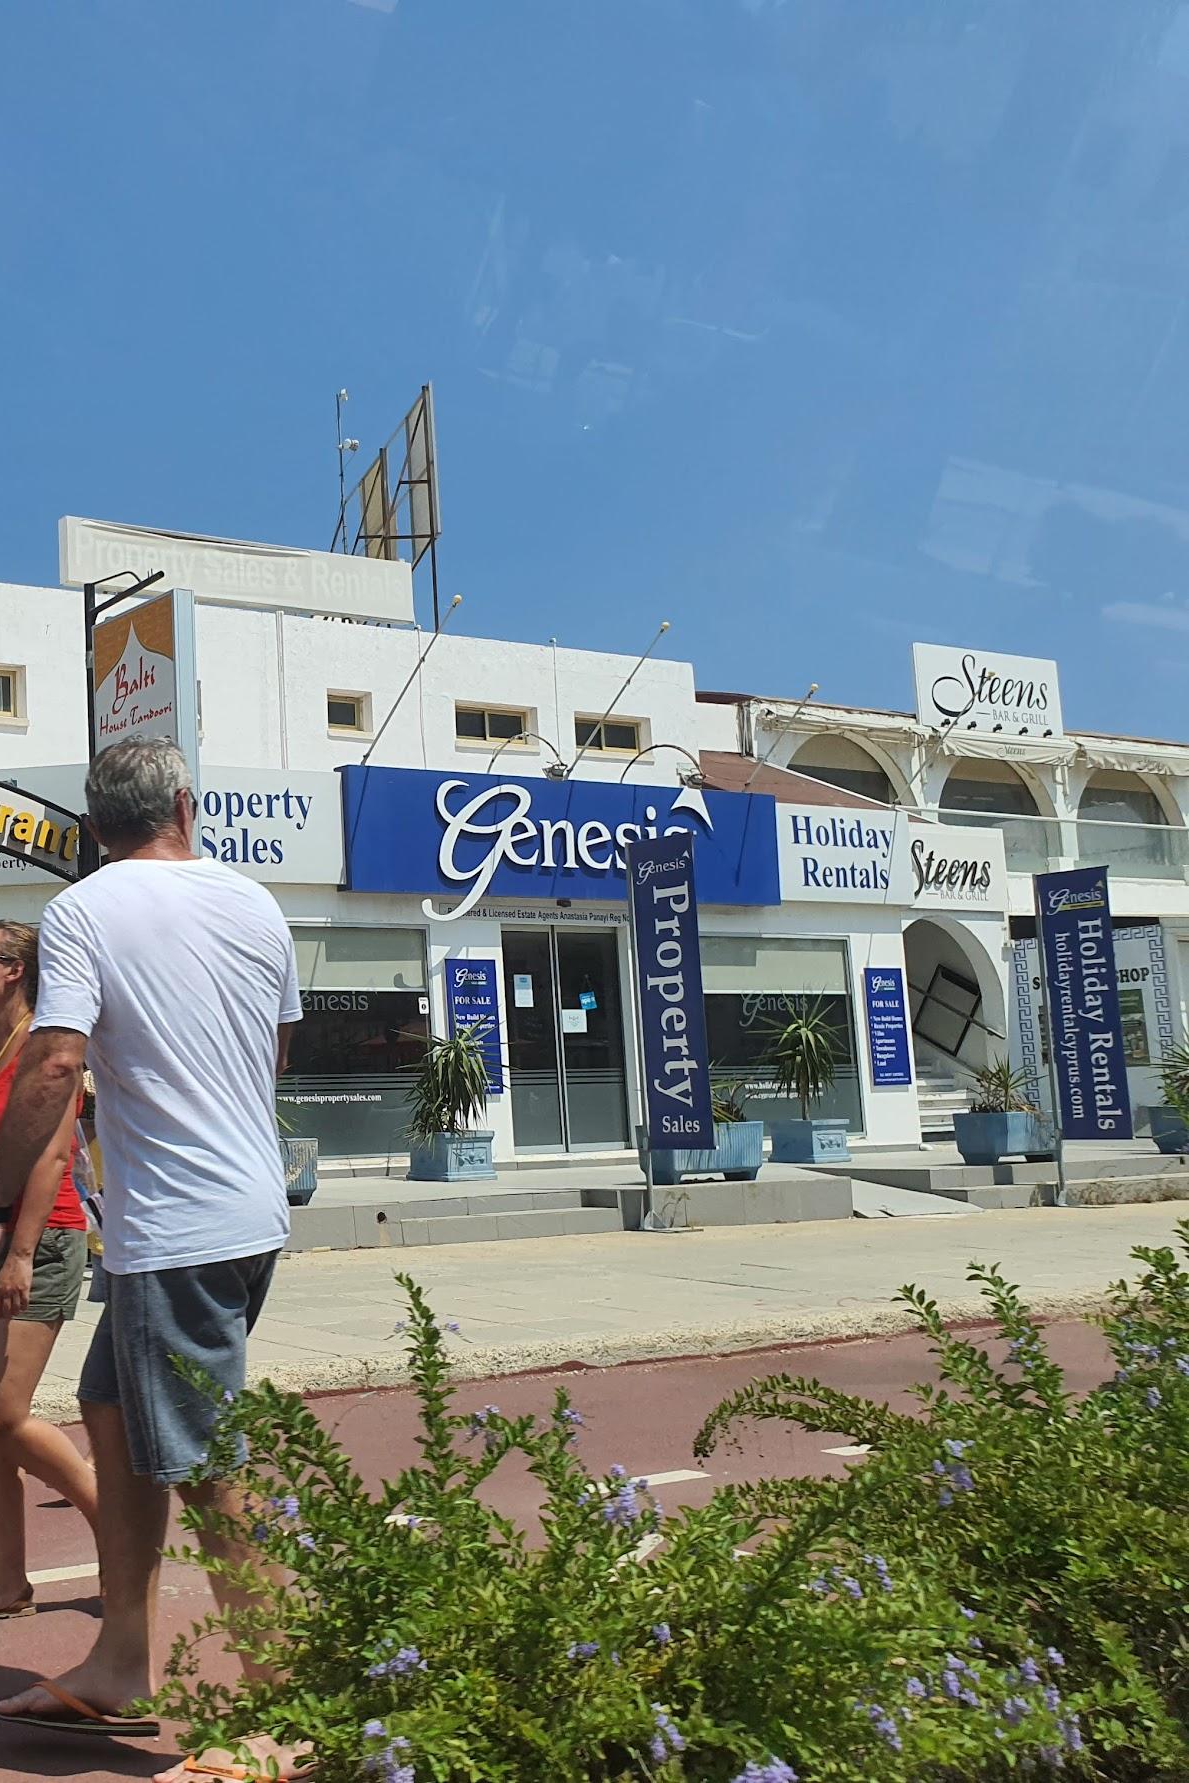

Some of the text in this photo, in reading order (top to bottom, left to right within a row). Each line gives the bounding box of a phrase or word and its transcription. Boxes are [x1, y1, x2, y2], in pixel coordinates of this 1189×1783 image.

[112, 656, 155, 715] Balti
[931, 654, 1048, 717] Steens
[100, 701, 172, 736] House Tandoori
[992, 709, 1049, 726] BAR & GRILL
[201, 826, 284, 864] Sales
[422, 779, 692, 921] Genesi
[791, 815, 894, 858] Holiday
[637, 859, 686, 886] Genesis
[801, 857, 890, 890] Rentals
[911, 839, 991, 898] Steens
[940, 890, 989, 902] BAR & GRILL
[1046, 888, 1102, 916] Genesis
[482, 908, 487, 917] &
[488, 908, 516, 918] Licensed
[517, 910, 536, 919] Estate
[538, 911, 559, 922] Agents
[560, 911, 588, 921] Anastasia
[454, 968, 486, 988] Genesis
[872, 976, 895, 993] Genesis
[1077, 917, 1109, 1024] Holiday
[301, 991, 369, 1011] enesis
[454, 996, 491, 1005] FOR SALE
[647, 880, 699, 1108] Property
[872, 1000, 899, 1008] FOR SALE
[1053, 932, 1085, 1120] holidayrentalcyprus.com
[1089, 1031, 1123, 1132] Rentals
[662, 1115, 700, 1133] Sales
